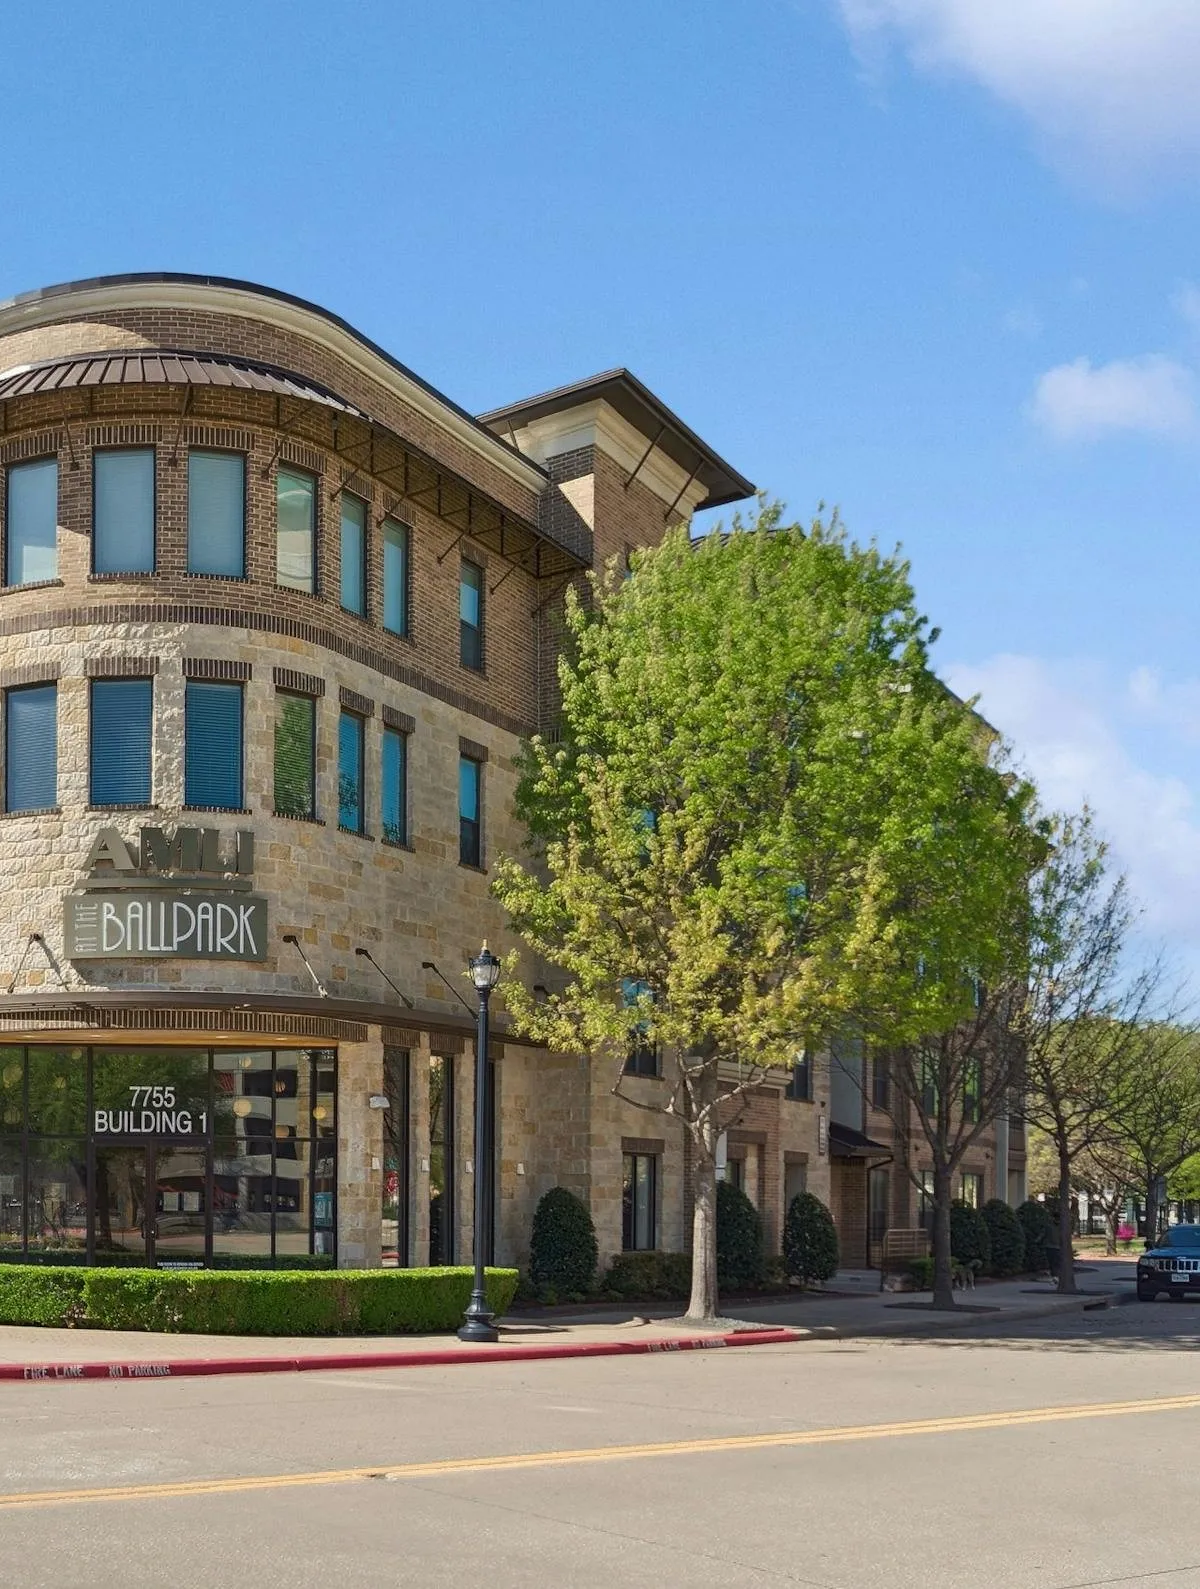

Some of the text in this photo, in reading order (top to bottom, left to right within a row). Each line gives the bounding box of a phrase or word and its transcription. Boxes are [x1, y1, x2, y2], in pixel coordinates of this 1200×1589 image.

[85, 827, 254, 873] AMLI
[74, 903, 98, 952] AT THE
[103, 901, 258, 955] BALLPARK
[129, 1086, 175, 1108] 7755
[95, 1111, 207, 1133] BUILDING 1
[24, 1364, 171, 1380] FIRE LANE NO PARKING
